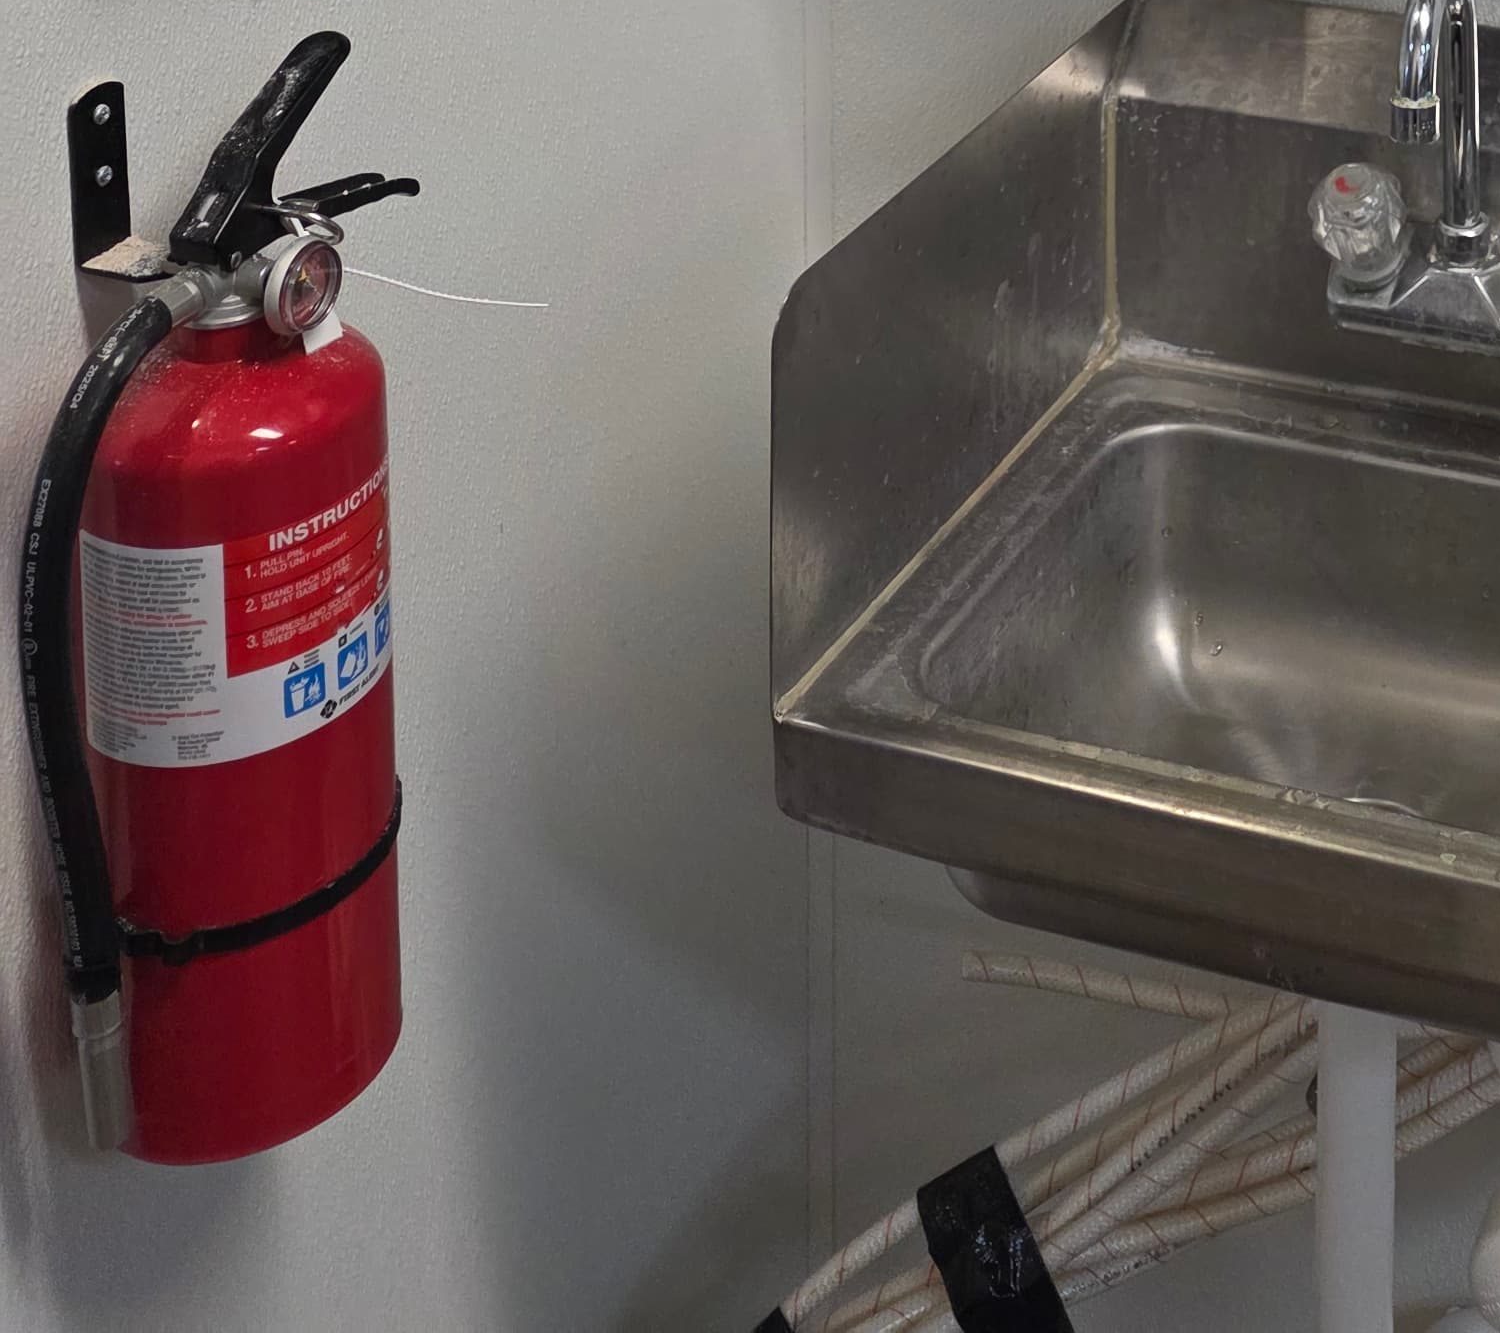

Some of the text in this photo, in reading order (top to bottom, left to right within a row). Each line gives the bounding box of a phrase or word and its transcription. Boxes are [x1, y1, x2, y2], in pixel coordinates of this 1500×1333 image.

[244, 564, 257, 580] 1.
[260, 554, 285, 570] PULL
[260, 563, 287, 579] HOLD
[260, 598, 280, 612] AIM
[281, 593, 294, 606] AT
[261, 628, 297, 649] SWEEP
